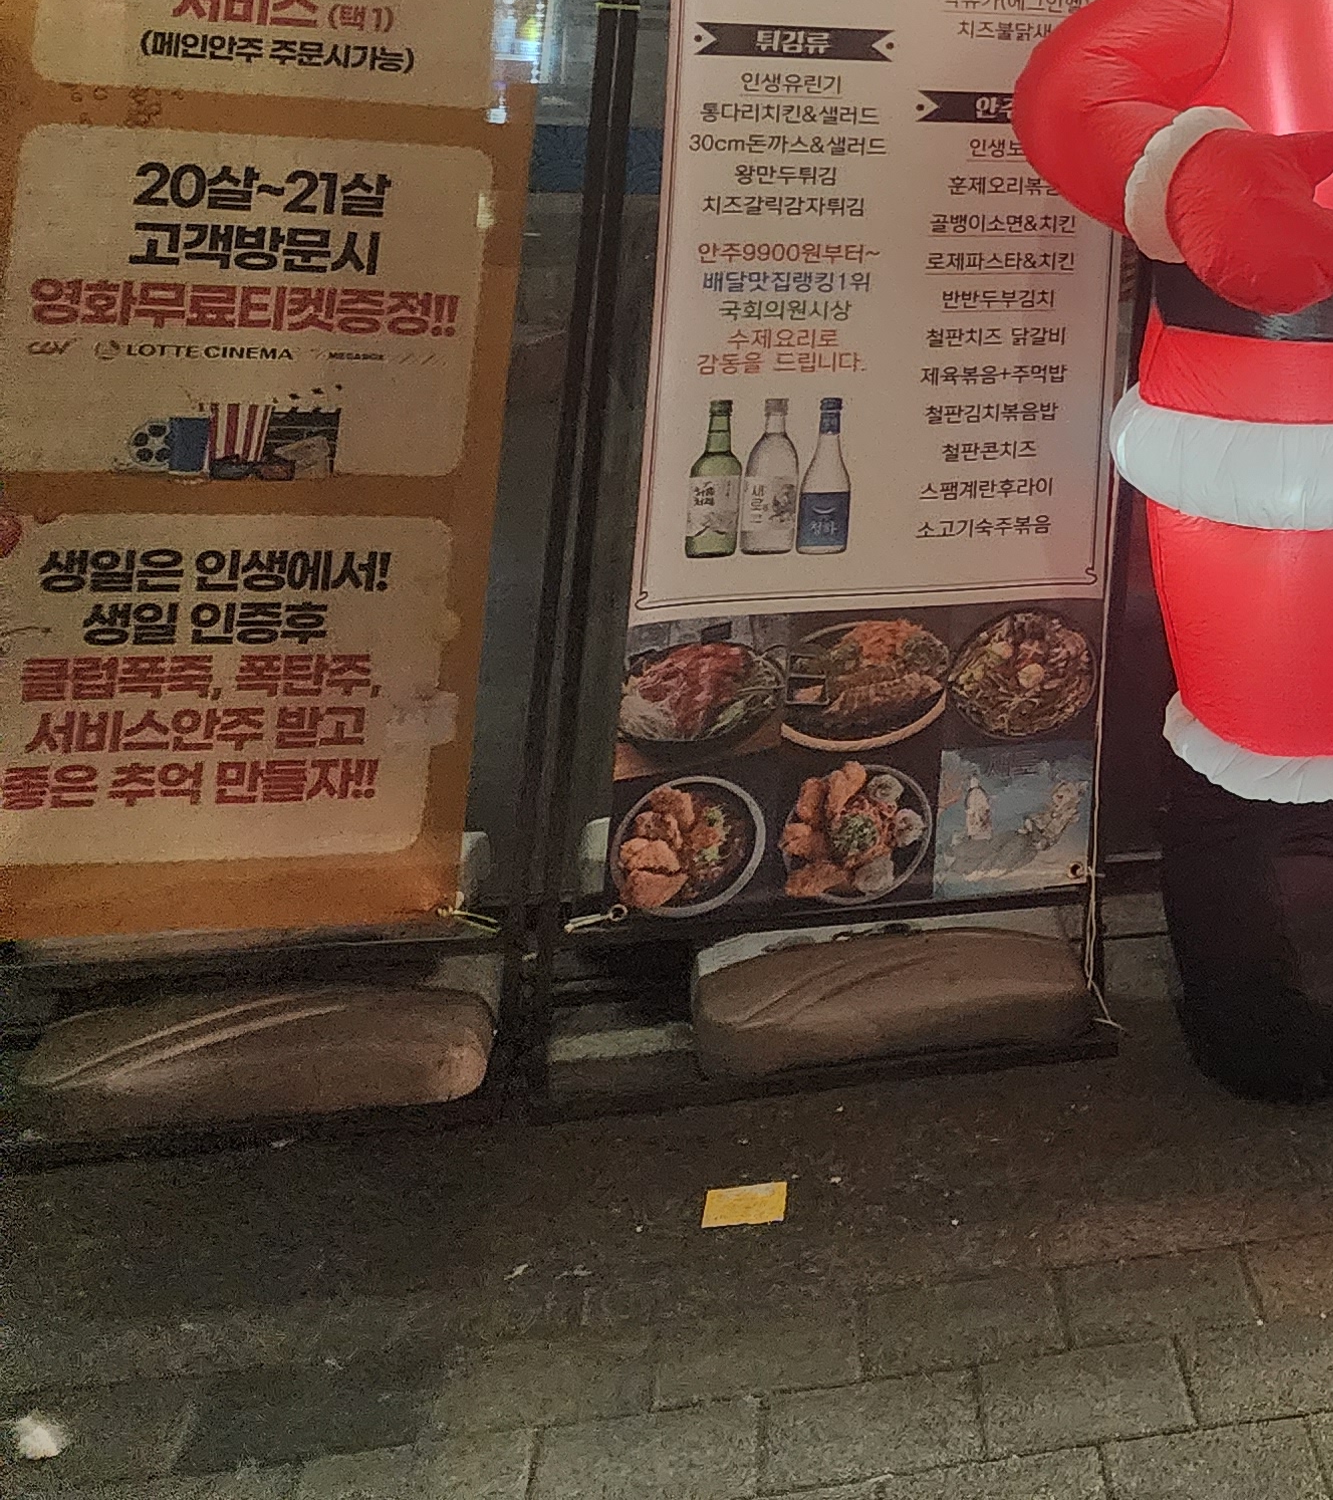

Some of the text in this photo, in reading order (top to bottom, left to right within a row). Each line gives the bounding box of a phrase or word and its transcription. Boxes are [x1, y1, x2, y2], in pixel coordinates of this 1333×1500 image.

[755, 29, 829, 54] 튀김류
[957, 20, 1052, 42] 치즈불닭새
[141, 30, 415, 74] (메인안주 주문시가능)
[740, 72, 843, 95] 인생유린기
[700, 102, 881, 126] 통다리치킨&샐러드
[975, 97, 1014, 119] 안주
[689, 132, 886, 157] 30cm돈까스&샐러드
[969, 138, 1026, 159] 인생보
[734, 163, 838, 187] 왕만두튀김
[132, 161, 392, 219] 20살~21살
[702, 194, 865, 219] 치즈갈릭감자튀김
[930, 213, 1076, 235] 골뱅이소면&치킨
[129, 221, 381, 276] 고객방문시
[698, 241, 881, 266] 안주9900원부터~
[925, 251, 1075, 272] 로제파스타&치킨
[702, 270, 872, 294] 배달맛집랭킹1위
[28, 277, 461, 339] 영화무료티켓증정!!
[718, 299, 852, 321] 국회의원시상
[941, 289, 1056, 311] 반반두부김치
[727, 328, 840, 351] 수제요리로
[925, 325, 1068, 348] 철판치즈 닭갈비
[126, 343, 294, 361] LOTTE CINEMA
[697, 351, 867, 376] 감동을 드립니다.
[920, 364, 1069, 387] 제육볶음+주먹밥
[924, 402, 1060, 426] 철판김치볶음밥
[941, 441, 1038, 462] 철판콘치즈
[920, 477, 1055, 501] 스팸계란후라이
[916, 517, 1053, 540] 소고기숙주볶음
[38, 547, 391, 594] 생일은 인생에서!
[83, 600, 328, 647] 생일 인증후
[20, 652, 383, 702] 클럽폭죽, 폭탄주,
[25, 706, 366, 753] 서비스안주 받고
[1, 758, 380, 811] 좋은 추억 만들자!!
